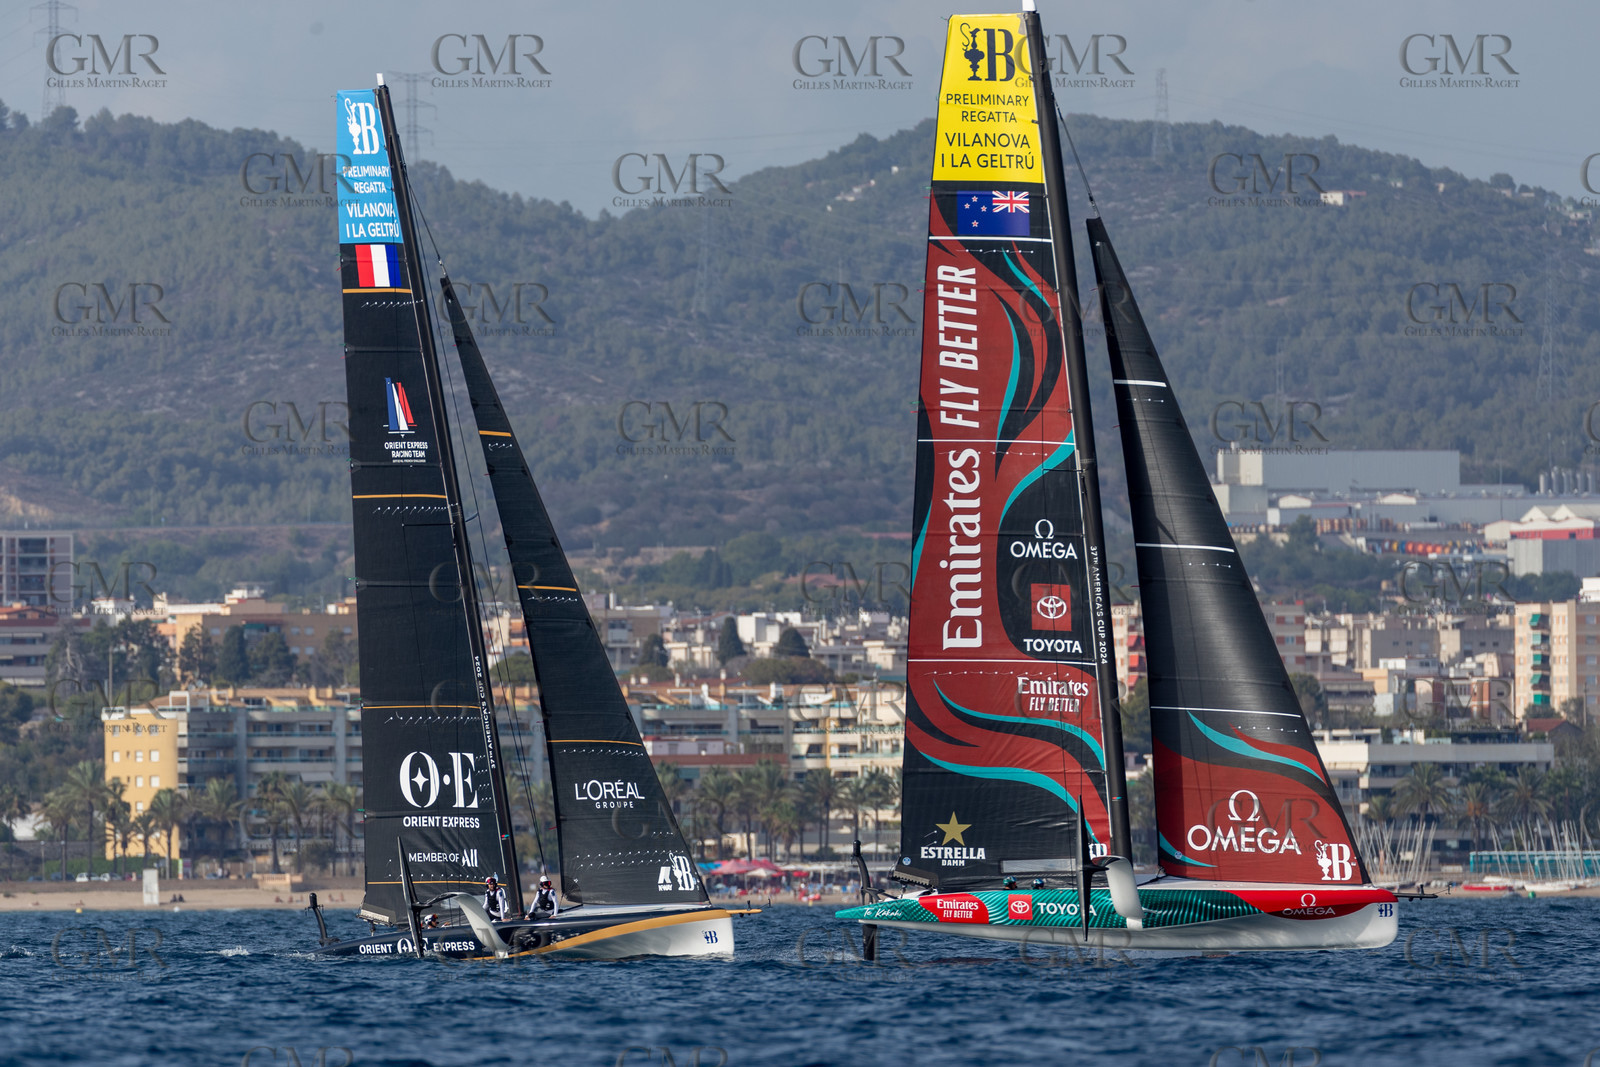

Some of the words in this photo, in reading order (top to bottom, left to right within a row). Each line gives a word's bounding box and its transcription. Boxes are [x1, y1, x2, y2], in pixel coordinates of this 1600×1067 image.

[946, 94, 1028, 106] PRELIMINARY
[962, 111, 1017, 123] REGATTA
[945, 133, 1030, 149] VILANOVA
[941, 153, 945, 168] I
[951, 154, 971, 168] LA
[977, 152, 1034, 170] GELTRÚ
[343, 166, 389, 178] PRELIMINARY
[354, 182, 386, 193] REGATTA
[346, 202, 395, 218] VILANOVA
[346, 223, 350, 238] I
[352, 223, 366, 238] LA
[368, 220, 399, 238] GELTRÚ
[937, 265, 978, 370] BETTER
[939, 378, 980, 428] FLY
[384, 441, 406, 449] ORIENT
[392, 450, 412, 458] RACING
[412, 450, 425, 458] TEAM
[940, 448, 982, 650] Emirates
[1010, 541, 1078, 559] OMEGA
[1097, 619, 1106, 638] CUP
[1023, 638, 1082, 653] TOYOTA
[1099, 641, 1108, 664] 2024
[474, 656, 482, 677] 2024
[1017, 677, 1089, 697] Emirates
[1029, 697, 1046, 711] FLY
[1048, 697, 1080, 713] BETTER
[595, 801, 634, 809] GROUPE
[403, 816, 441, 827] ORIENT
[442, 818, 480, 828] EXPRESS
[1187, 825, 1302, 854] OMEGA
[408, 852, 448, 862] MEMBER
[449, 853, 460, 862] OF
[920, 847, 986, 859] ESTRELLA
[937, 898, 979, 910] Emirates
[1282, 907, 1335, 915] OMEGA
[864, 908, 874, 917] Te
[944, 910, 953, 918] FLY
[954, 910, 973, 918] BETTER
[359, 944, 392, 954] ORIENT
[433, 941, 475, 952] EXPRESS
